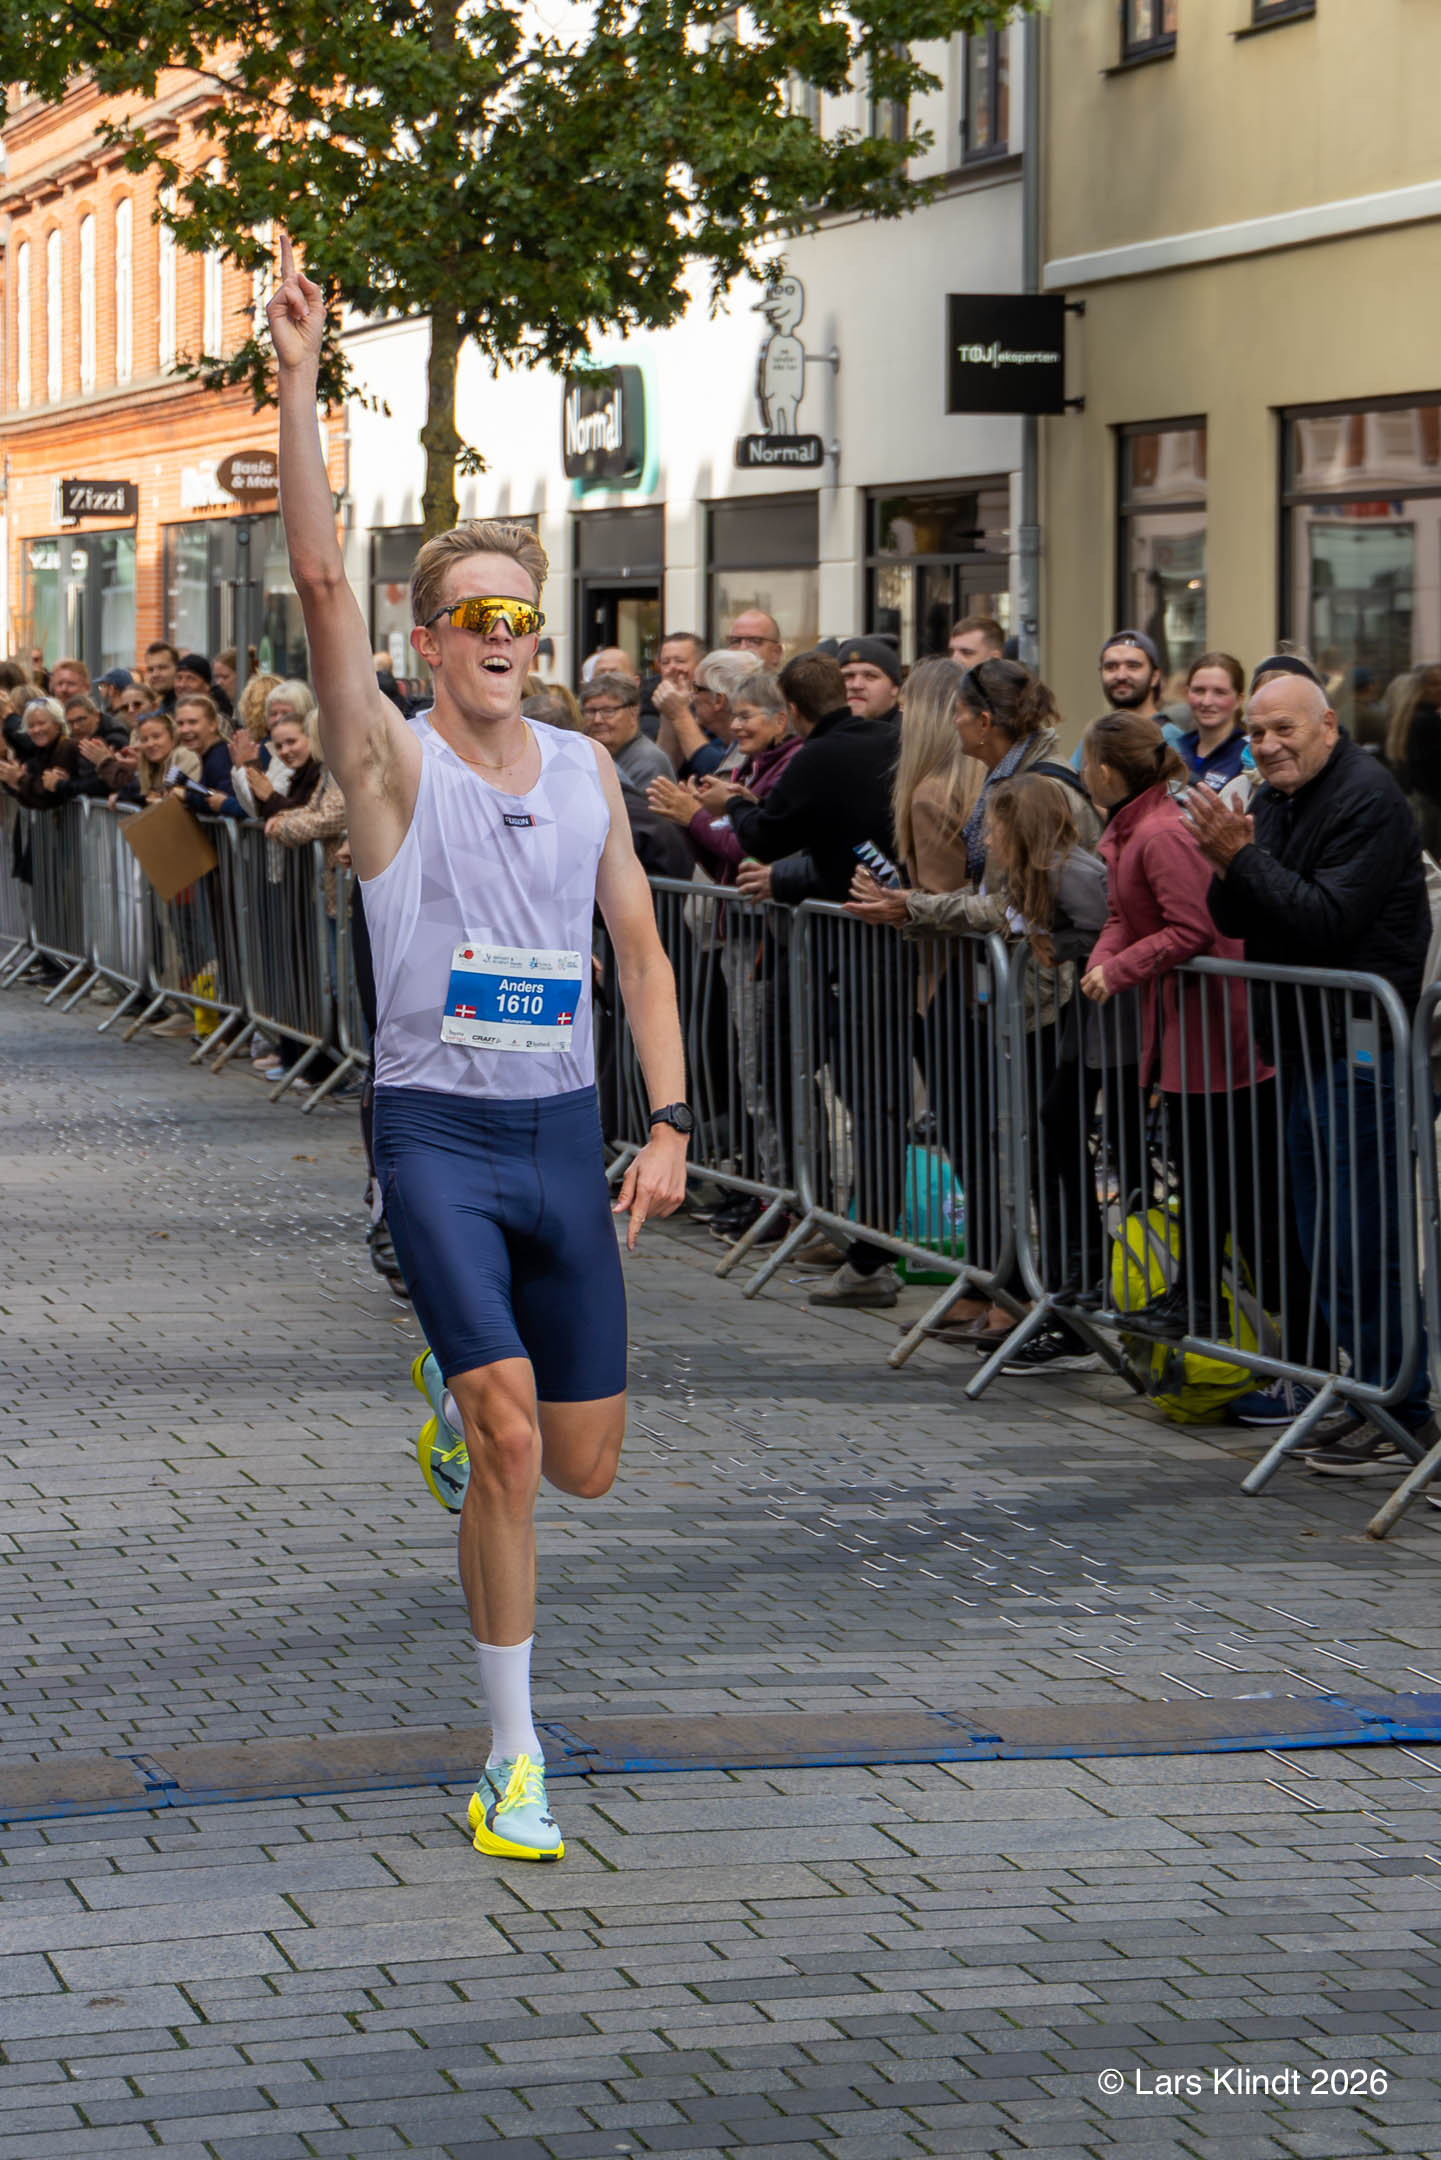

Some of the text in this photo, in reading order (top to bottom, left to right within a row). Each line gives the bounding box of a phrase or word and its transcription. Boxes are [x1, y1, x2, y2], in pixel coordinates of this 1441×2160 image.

[566, 387, 623, 456] Normal
[749, 440, 817, 463] Normal
[231, 460, 274, 475] Basic
[231, 475, 245, 489] &
[69, 487, 126, 511] Zizzi
[499, 978, 544, 993] Anders
[496, 993, 543, 1015] 1610
[472, 1034, 497, 1043] CRAFT
